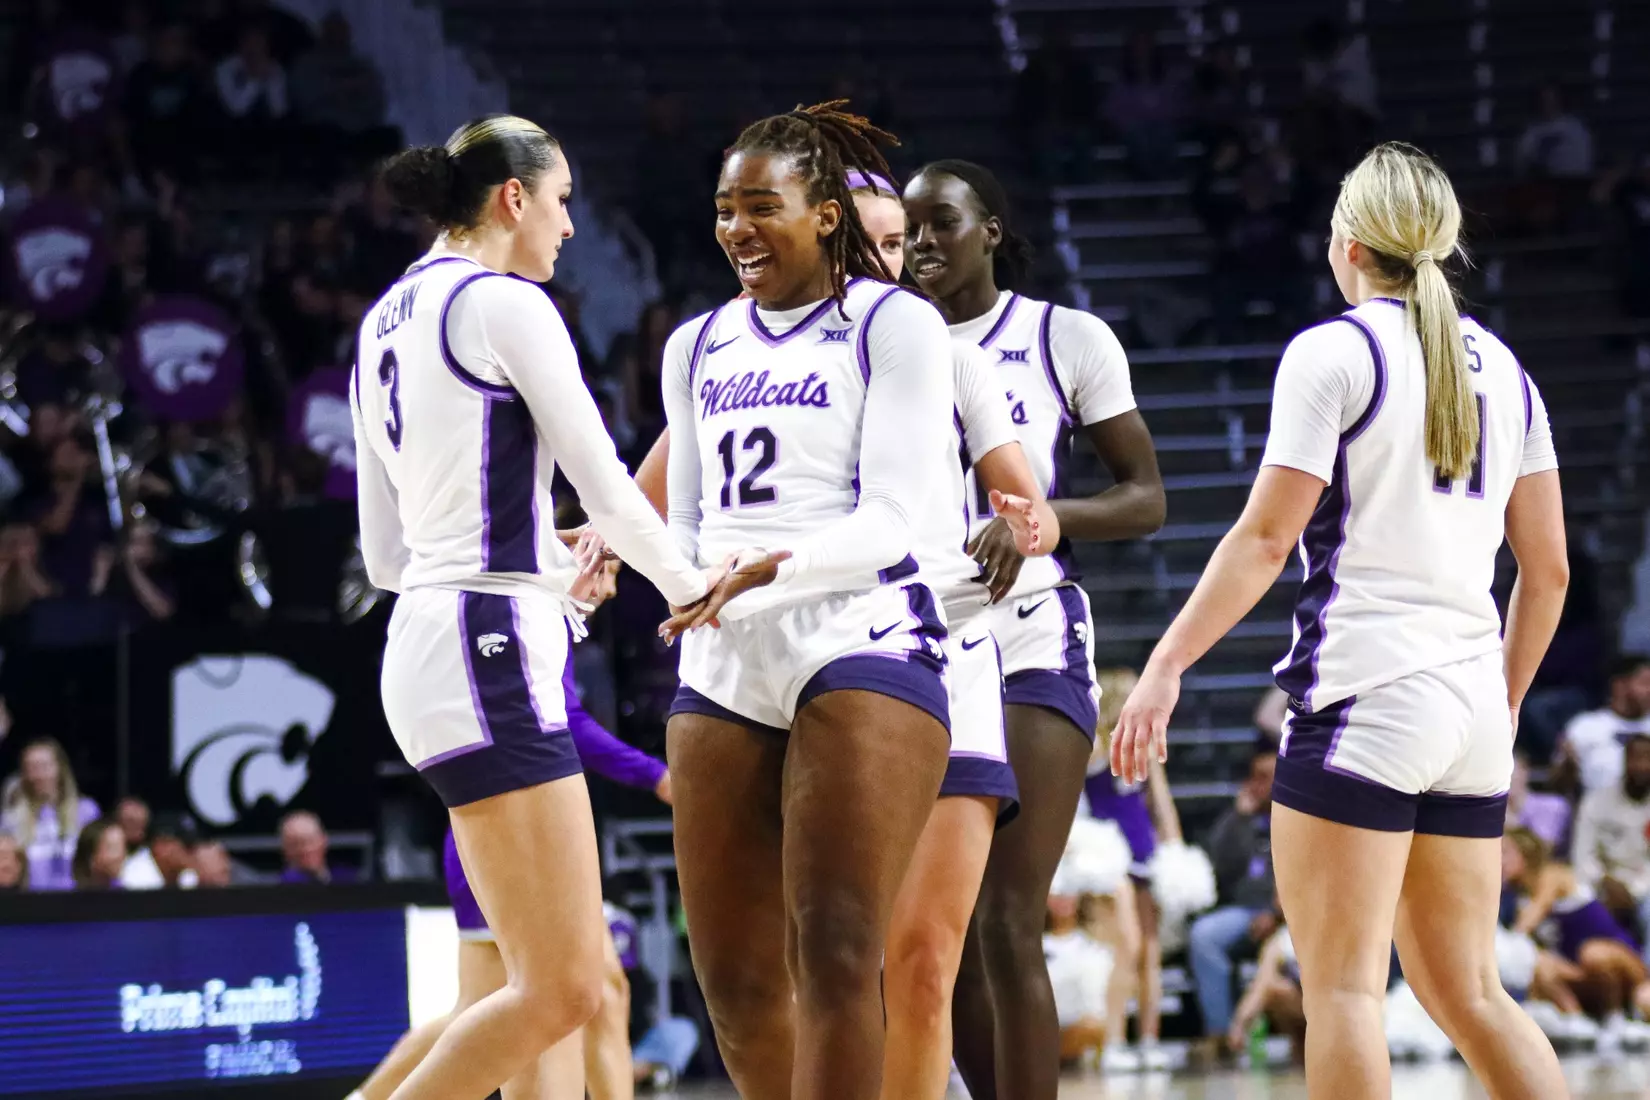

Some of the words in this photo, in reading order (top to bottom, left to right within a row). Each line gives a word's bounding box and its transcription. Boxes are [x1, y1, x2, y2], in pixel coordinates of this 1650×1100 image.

[376, 281, 423, 340] GLENN
[821, 327, 851, 343] XII
[1000, 349, 1028, 362] XII
[378, 346, 403, 453] 3
[700, 369, 831, 421] Wildcats
[718, 425, 780, 511] 12
